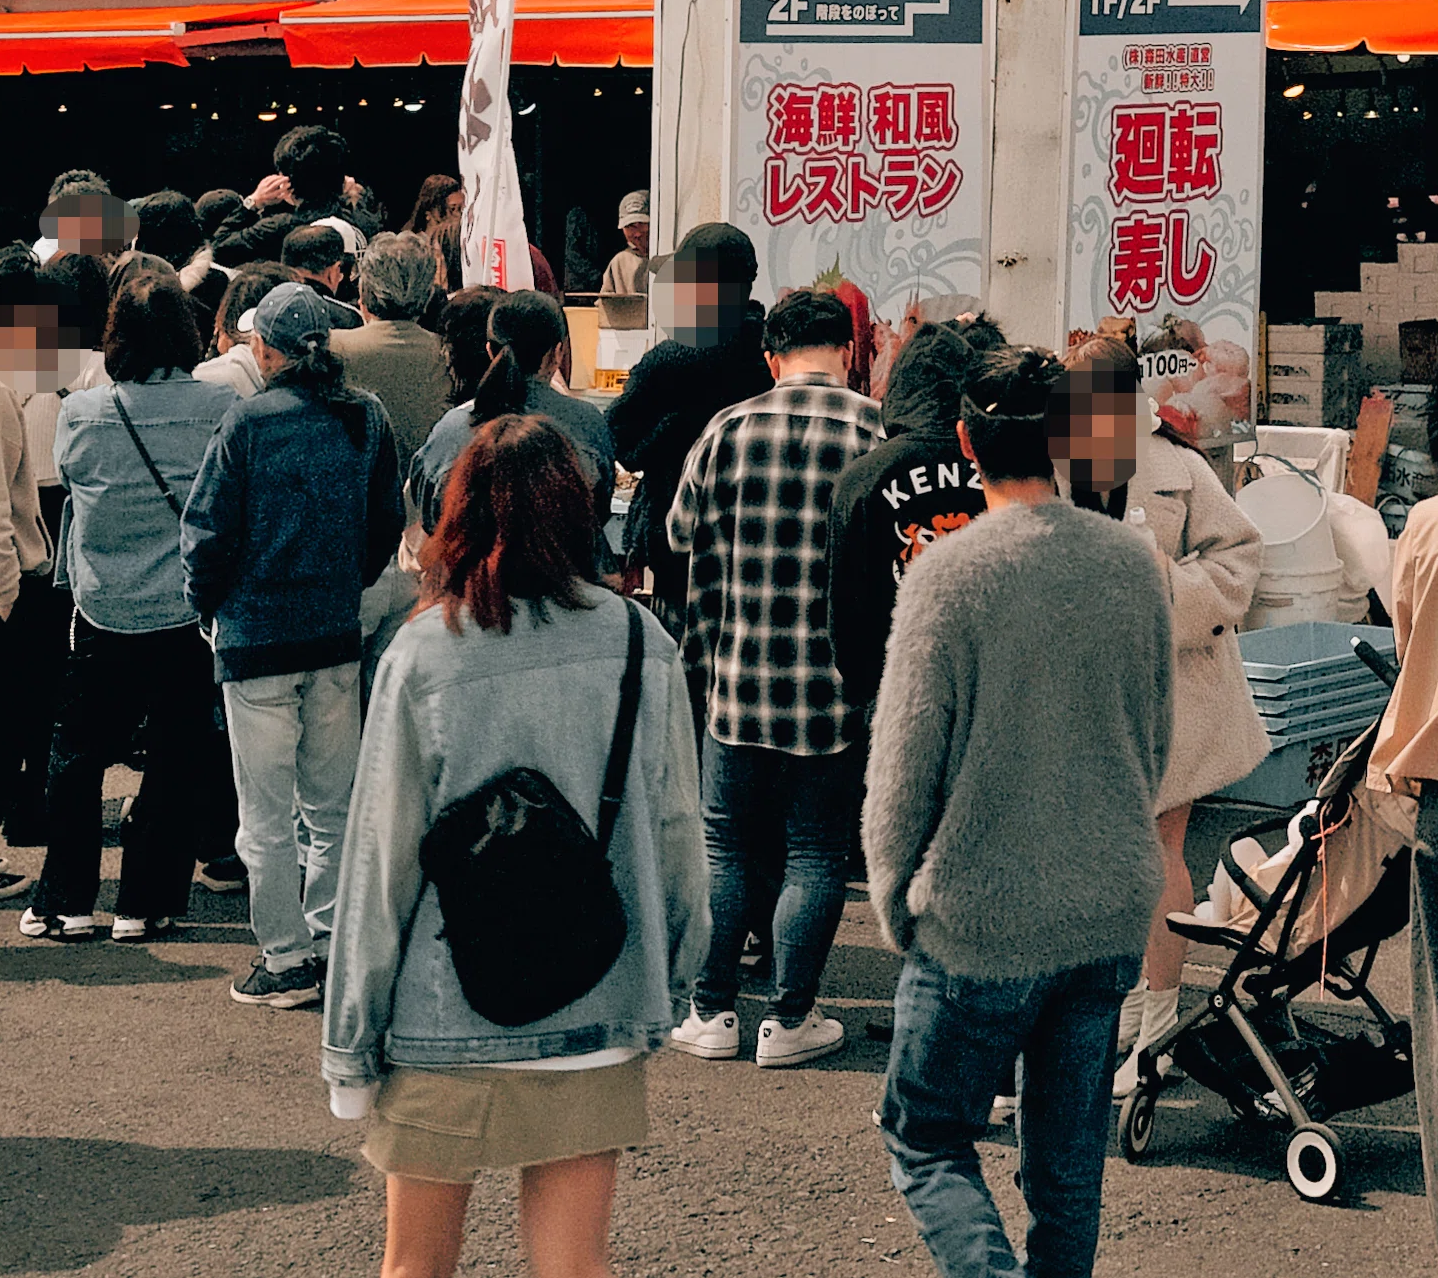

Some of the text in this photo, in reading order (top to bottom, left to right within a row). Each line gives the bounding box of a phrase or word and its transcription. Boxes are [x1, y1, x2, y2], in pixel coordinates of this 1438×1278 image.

[815, 2, 900, 22] 階段をのぼって
[1123, 43, 1212, 69] (株)森田水産 直営
[767, 83, 959, 154] 海鮮 和風
[1109, 101, 1222, 207] 廻転
[762, 153, 963, 226] レストラン
[1109, 208, 1217, 313] 寿し
